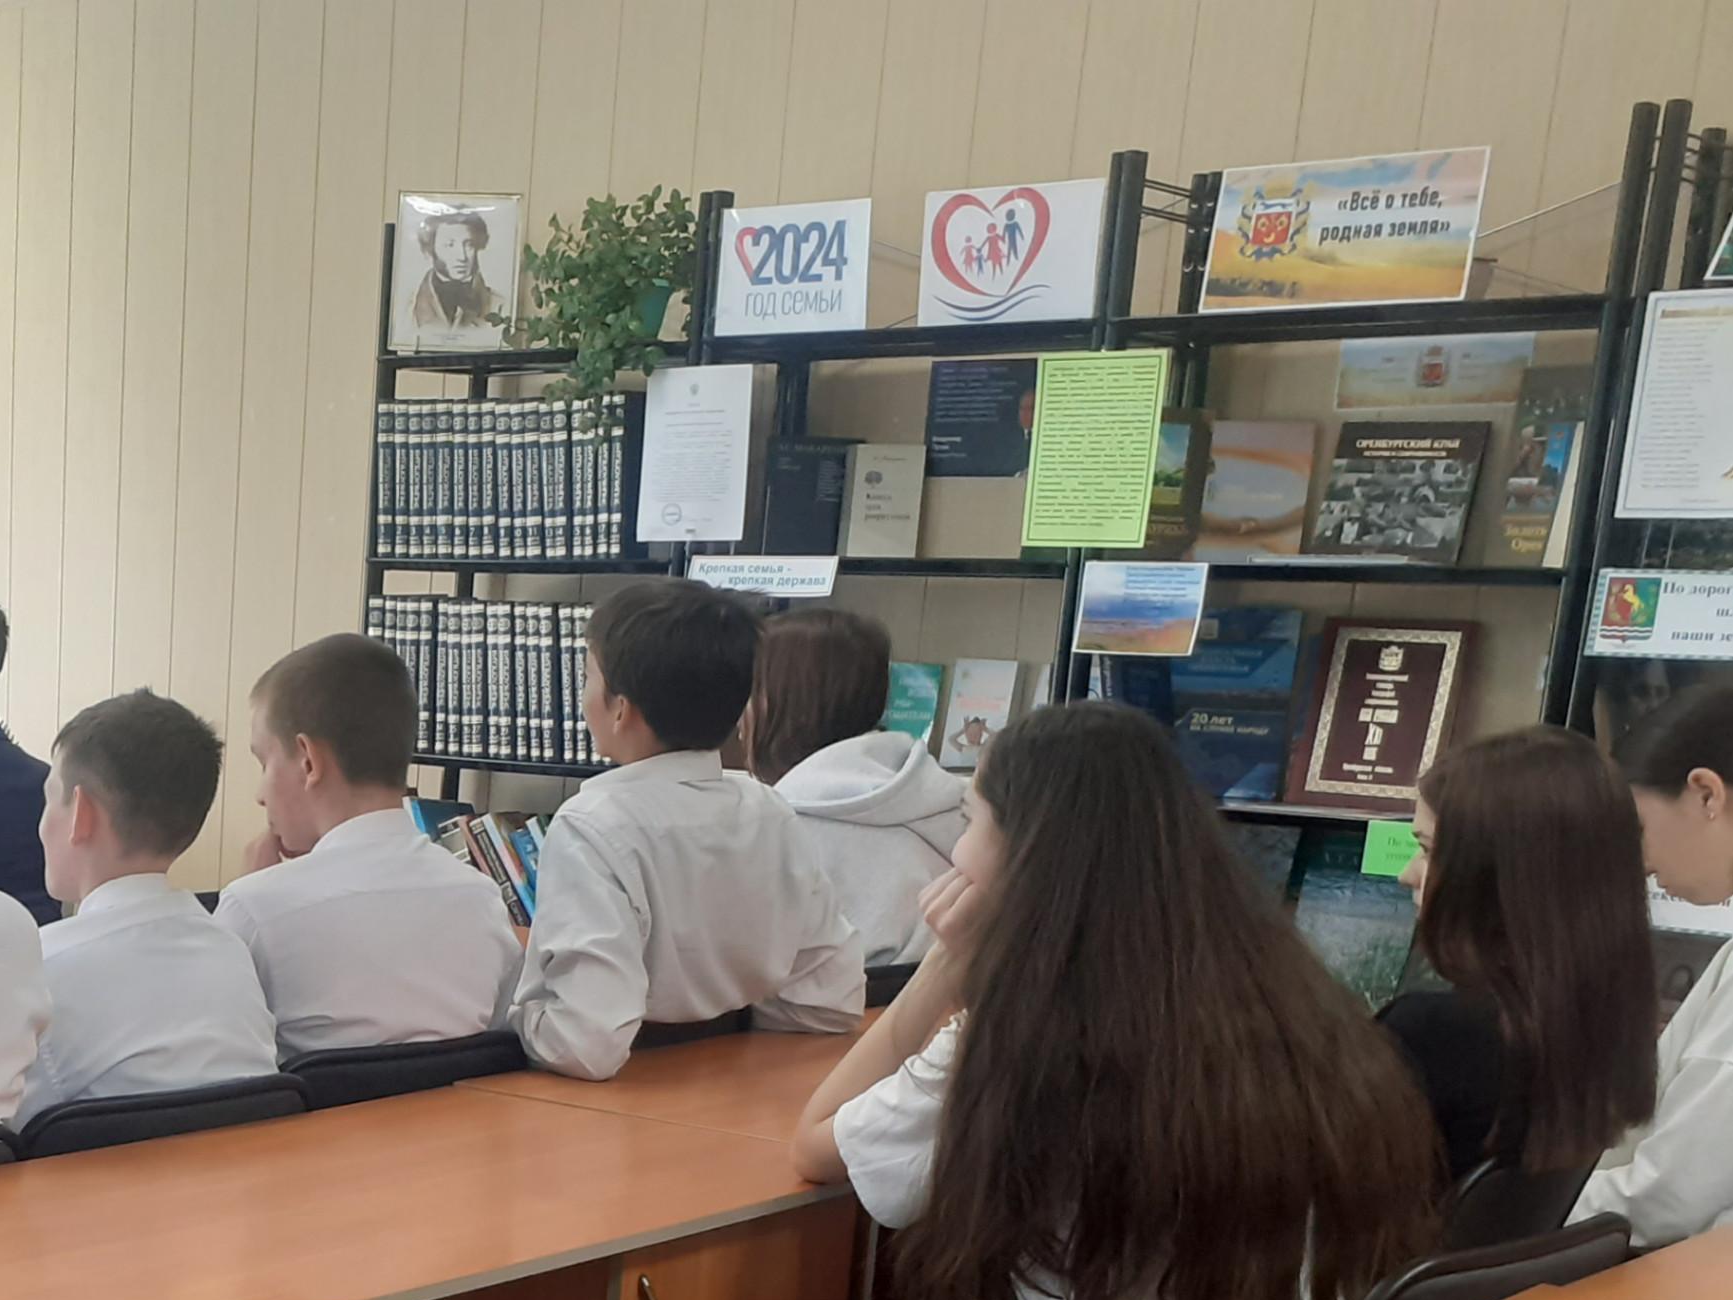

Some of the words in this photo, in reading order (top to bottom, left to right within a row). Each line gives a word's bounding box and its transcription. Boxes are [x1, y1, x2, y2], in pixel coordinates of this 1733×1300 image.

[1337, 189, 1381, 212] «Всё
[1384, 194, 1395, 210] о
[1400, 185, 1443, 208] тебе,
[1318, 222, 1384, 247] родная
[1387, 219, 1451, 238] земля»
[751, 219, 849, 286] 2024
[698, 562, 745, 574] Крепкая
[747, 564, 784, 574] семья
[728, 576, 774, 585] крепкая
[776, 576, 827, 588] держава
[1663, 582, 1685, 594] По
[1191, 712, 1209, 725] 20
